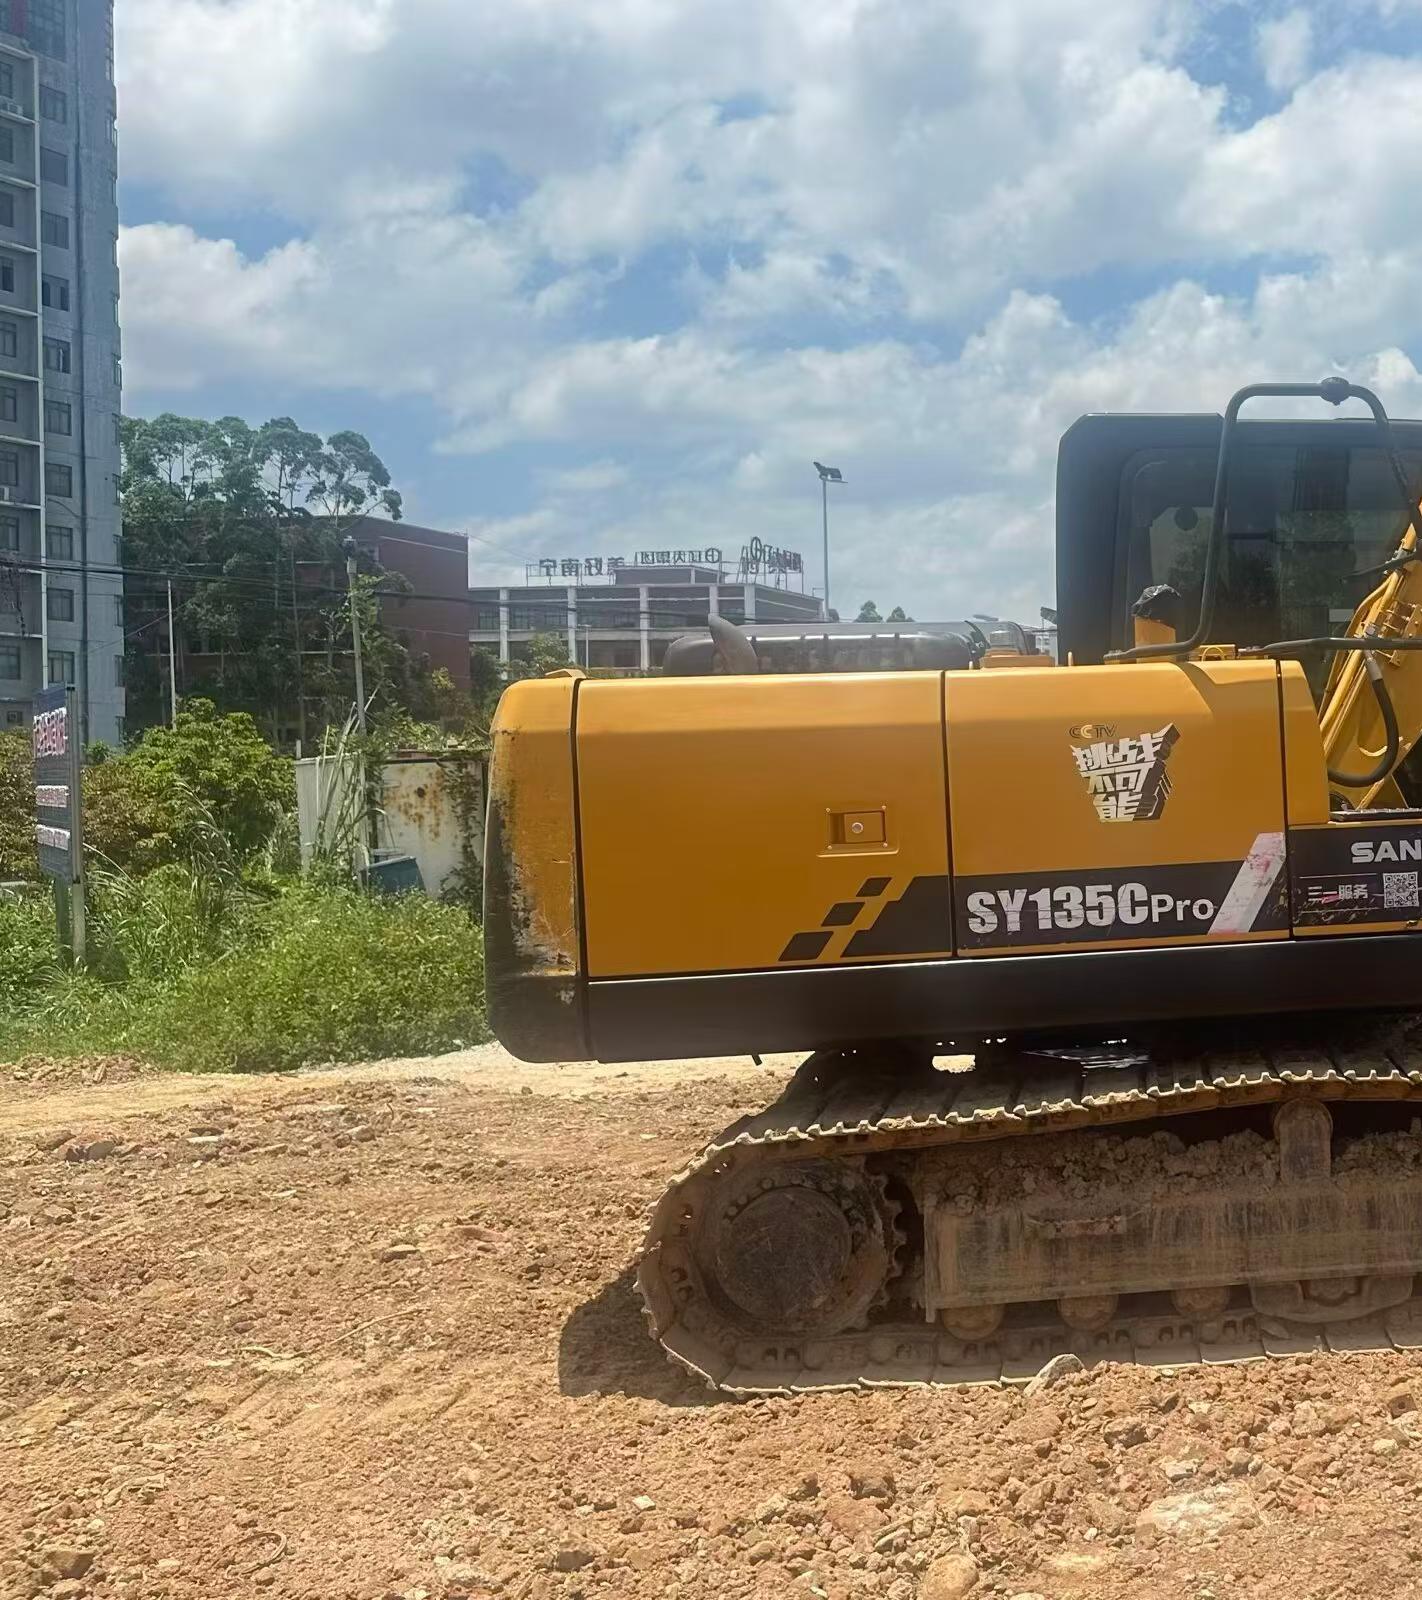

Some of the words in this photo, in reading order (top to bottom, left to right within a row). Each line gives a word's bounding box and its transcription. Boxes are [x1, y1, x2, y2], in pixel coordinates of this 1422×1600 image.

[1069, 724, 1117, 739] CCTV
[1308, 884, 1369, 902] 三一服务
